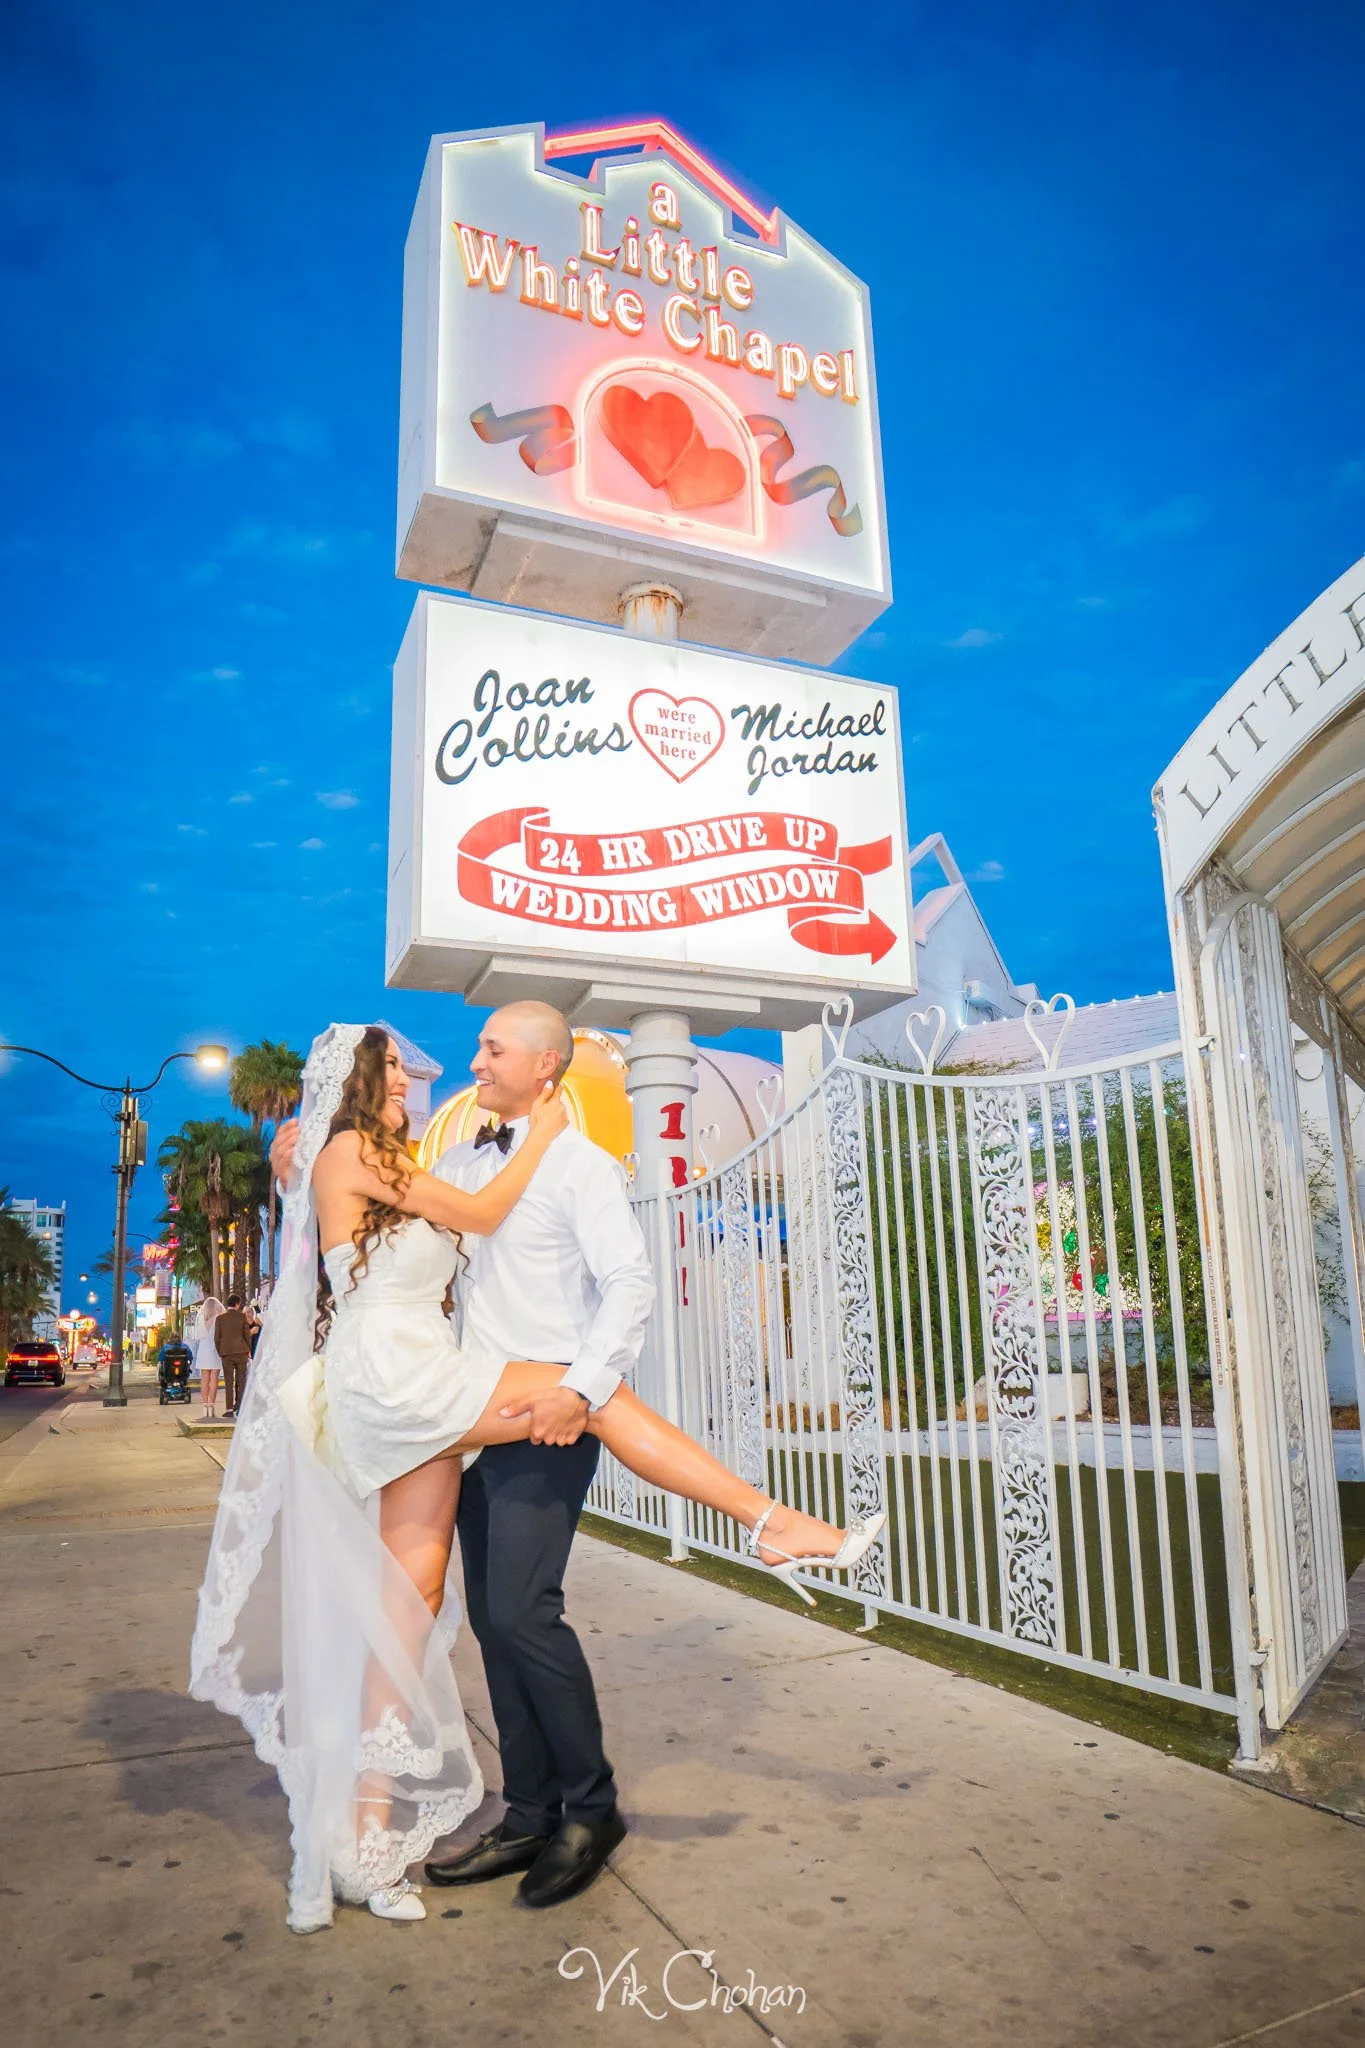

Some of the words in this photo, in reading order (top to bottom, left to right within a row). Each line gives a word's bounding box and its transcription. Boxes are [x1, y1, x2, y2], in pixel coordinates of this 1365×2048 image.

[649, 182, 681, 229] a
[580, 201, 754, 310] Little
[452, 222, 646, 335] White
[662, 294, 860, 403] Chapel
[474, 669, 595, 737] Joan
[657, 706, 697, 723] were
[731, 699, 887, 743] Michael
[435, 713, 633, 785] Collins
[644, 721, 712, 746] married
[660, 742, 697, 761] here
[746, 744, 879, 795] Jordan
[539, 838, 581, 874] 24
[597, 837, 653, 870] HR
[665, 816, 768, 861] DRIVE
[783, 816, 827, 851] UP
[490, 869, 679, 927] WEDDING
[693, 868, 841, 919] WINDOW
